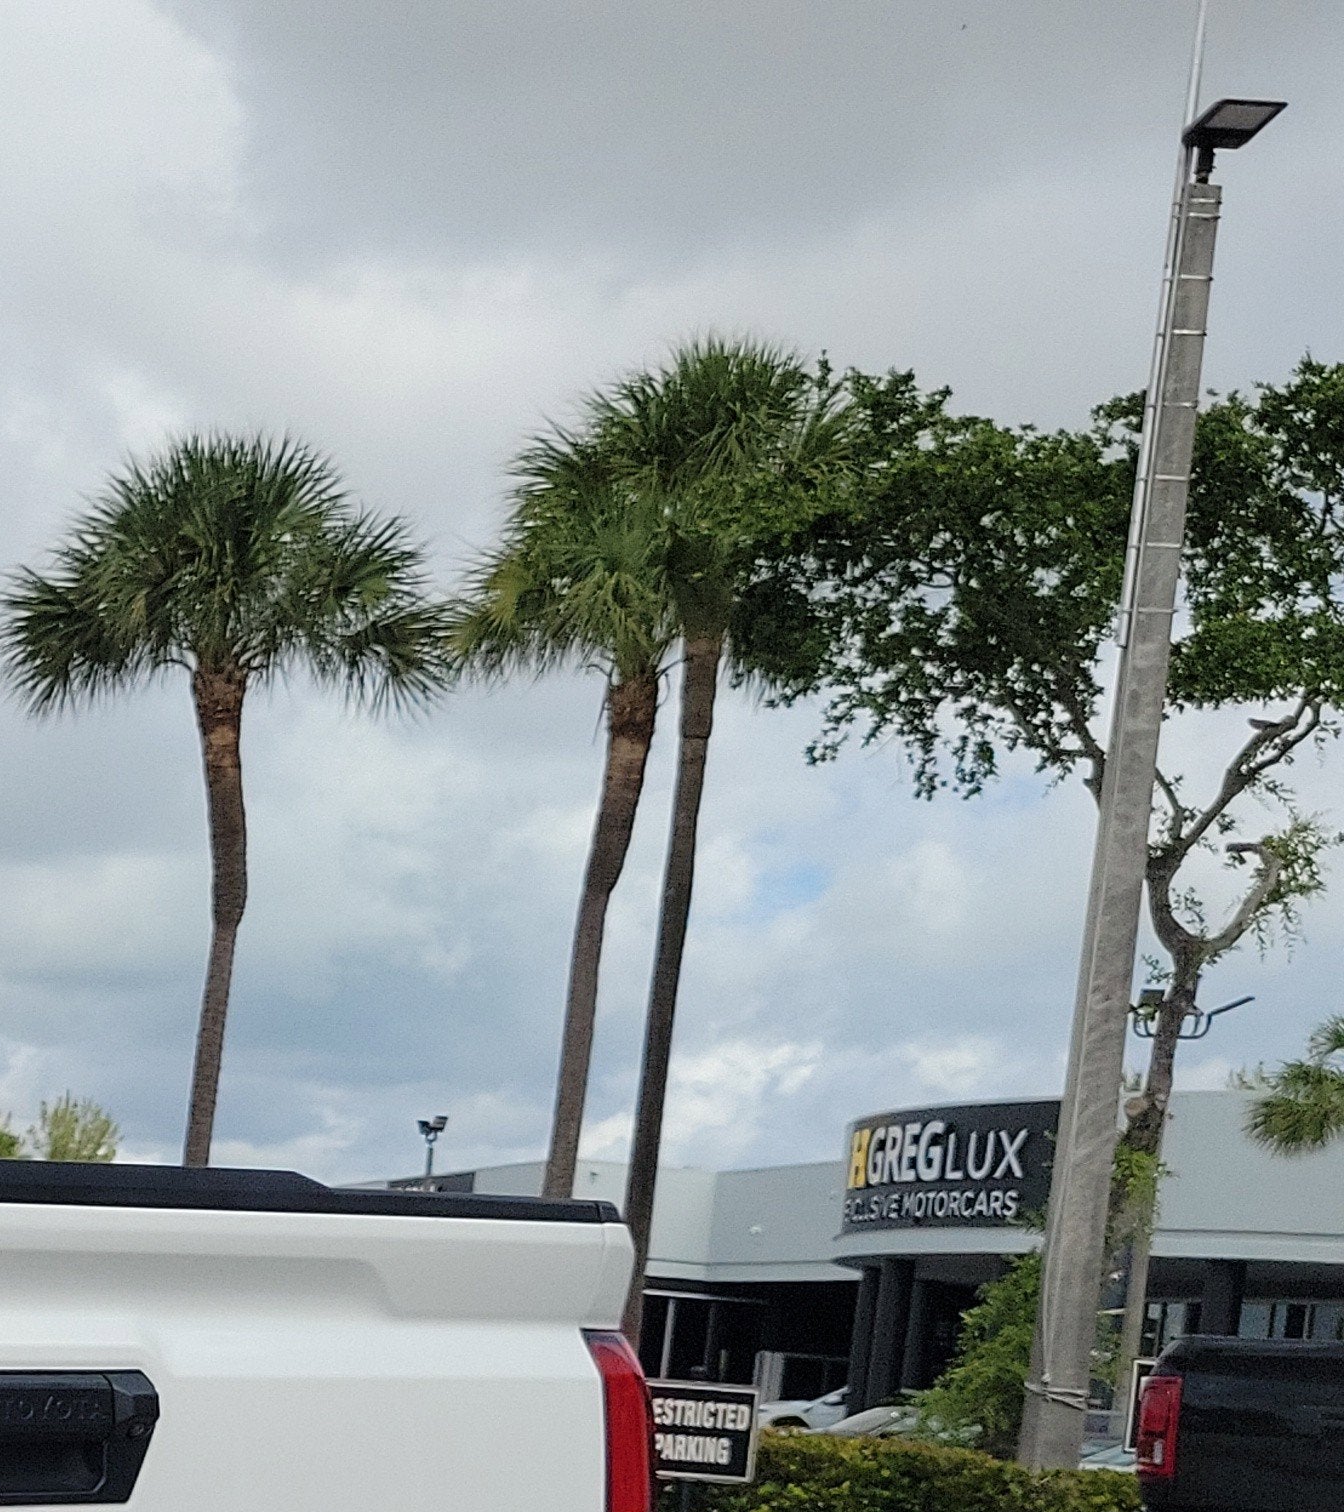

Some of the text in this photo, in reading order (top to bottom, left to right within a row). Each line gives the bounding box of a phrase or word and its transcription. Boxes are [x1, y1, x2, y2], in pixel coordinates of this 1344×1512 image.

[901, 1190, 1019, 1219] MOTORCARS
[652, 1397, 752, 1432] ESTRICTED
[654, 1432, 733, 1466] PARKING
